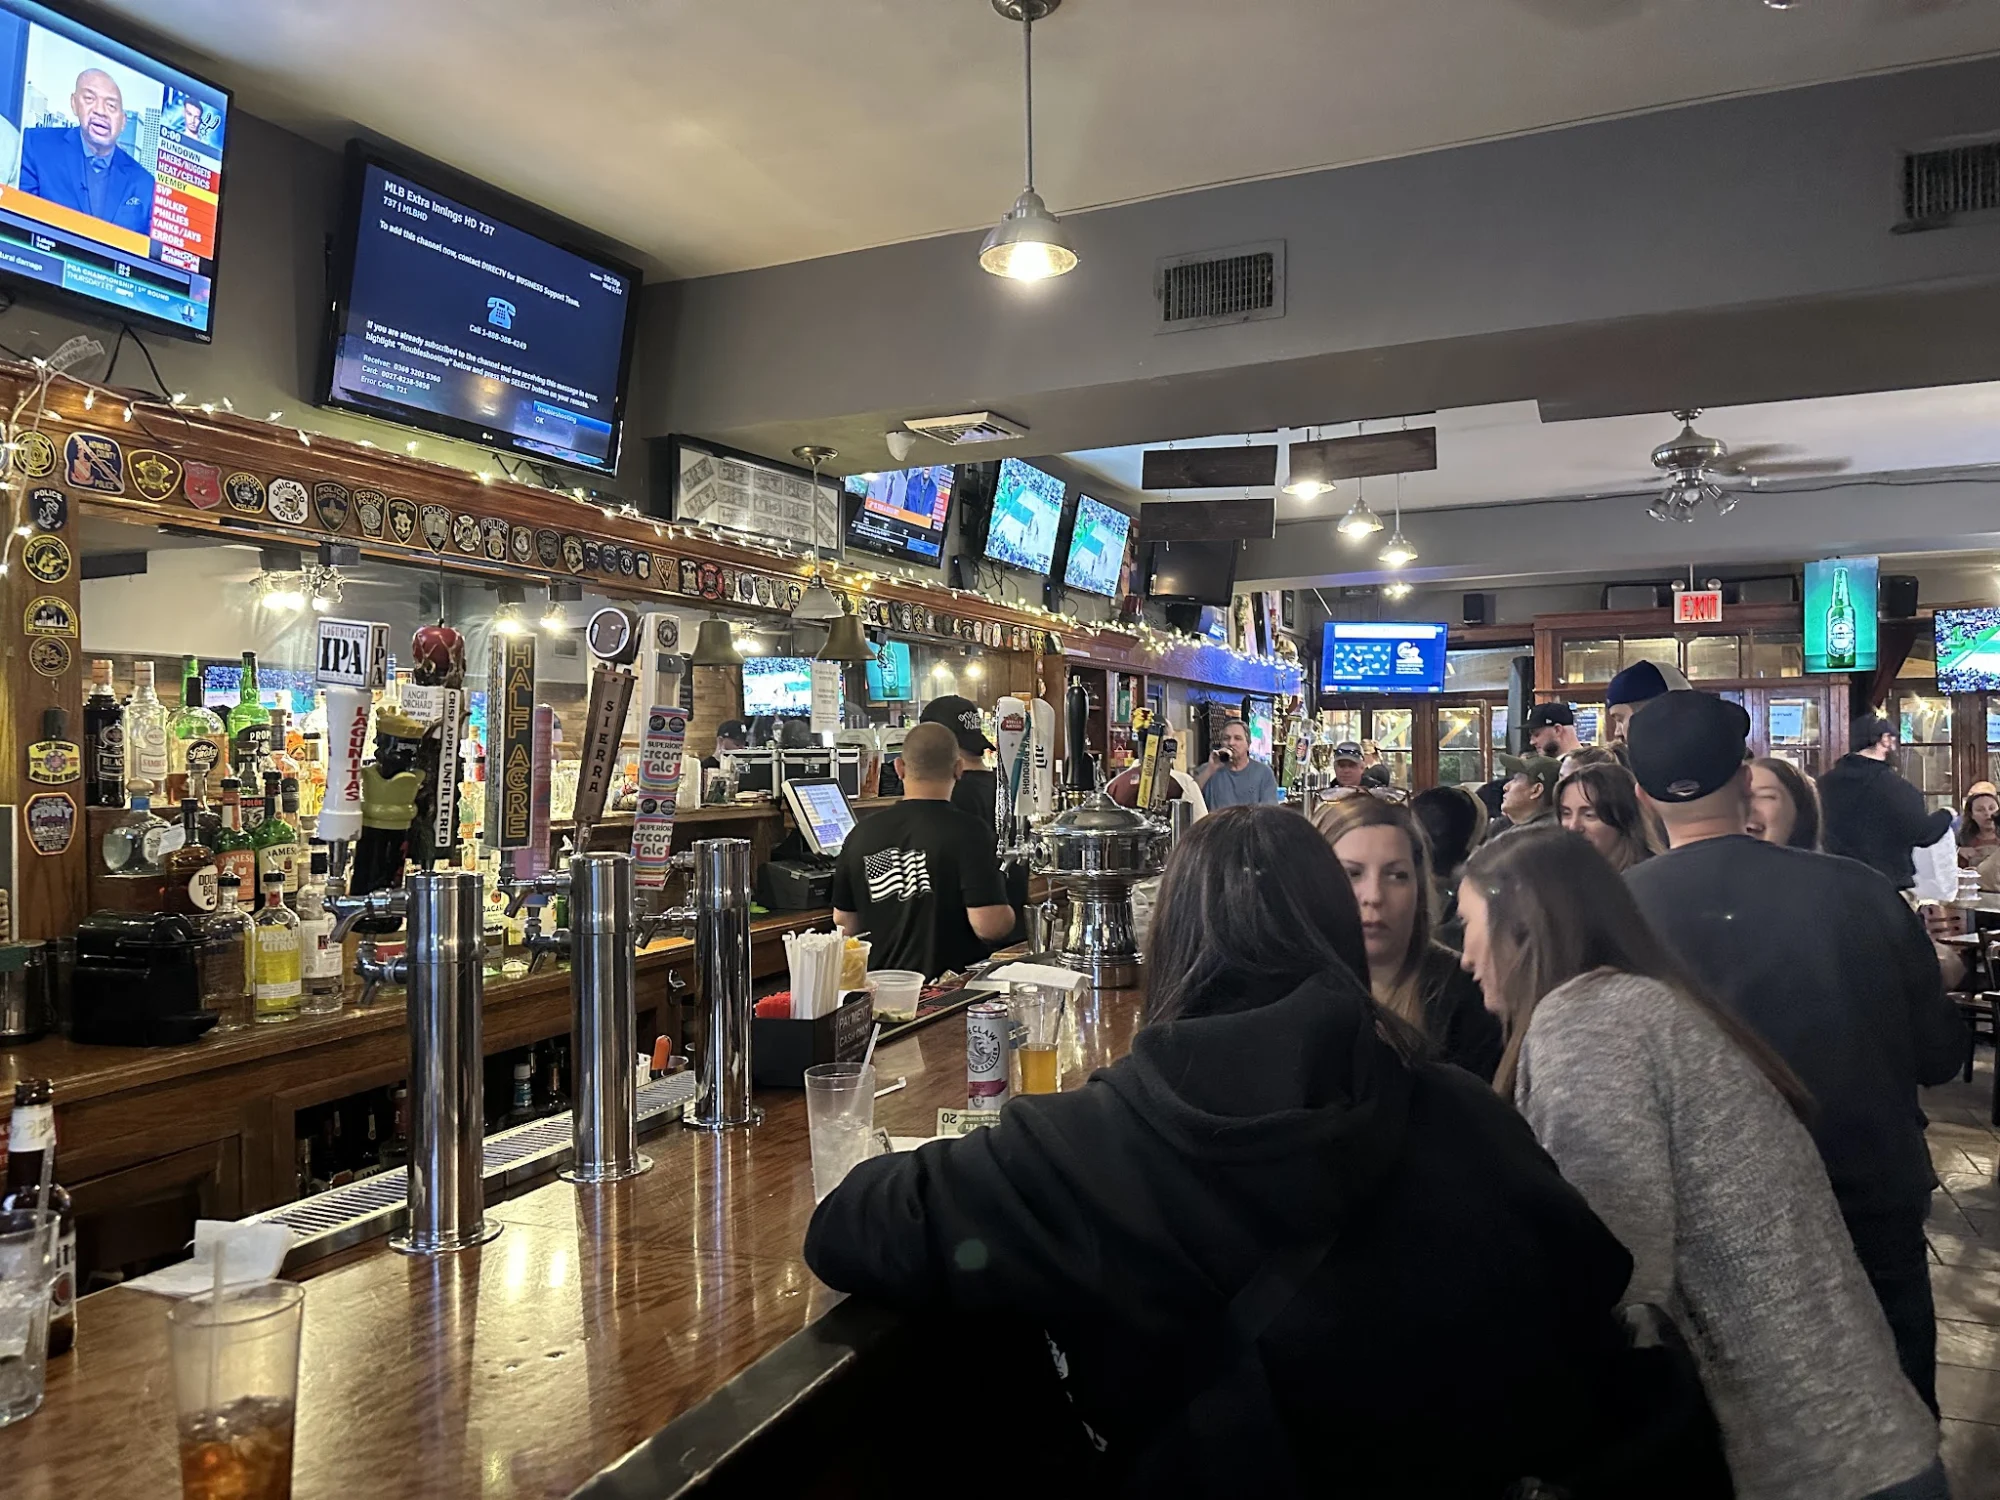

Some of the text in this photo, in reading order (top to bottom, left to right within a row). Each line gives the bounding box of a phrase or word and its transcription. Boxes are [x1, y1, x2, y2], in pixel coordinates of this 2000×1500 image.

[161, 127, 181, 142] 0:00
[161, 139, 200, 162] RUNDOWN
[160, 150, 212, 180] LAKERS/NUGGETS
[158, 161, 210, 190] HEAT/CELTICS
[158, 173, 187, 191] WEMBY
[155, 184, 173, 197] SVP
[155, 195, 188, 214] MULKEY
[383, 196, 397, 209] 737
[402, 204, 429, 221] MLBHD
[384, 180, 496, 237] MLB Extra Innings HD 737
[154, 206, 189, 227] PHILLIES
[151, 228, 185, 248] ERRORS
[152, 217, 202, 243] YANKS/JAYS
[379, 219, 389, 230] To
[389, 224, 403, 236] add
[403, 230, 416, 241] this
[416, 236, 443, 253] channel
[442, 247, 458, 260] now,
[457, 253, 481, 268] contact
[480, 261, 507, 279] DIRECTV
[506, 271, 516, 281] for
[515, 275, 544, 293] BUSINESS
[543, 286, 565, 301] Support
[67, 271, 101, 288] THURSDAY
[82, 267, 134, 290] CHAMPIONSHIP
[147, 289, 170, 302] ROUND
[469, 324, 482, 335] Call
[363, 354, 391, 369] Receiver:
[366, 320, 374, 329] If
[374, 323, 387, 333] you
[388, 328, 399, 337] are
[400, 332, 424, 347] already
[425, 340, 458, 356] subscribed
[458, 350, 466, 358] to
[466, 353, 476, 362] the
[477, 357, 500, 369] channel
[500, 364, 512, 374] and
[512, 369, 522, 377] are
[522, 372, 546, 387] receiving
[546, 379, 557, 389] this
[557, 383, 579, 397] message
[362, 365, 379, 376] Card:
[365, 332, 590, 409] highlight "Troubleshooting" below and press the SELECT button on your remote.
[360, 375, 377, 386] Error
[378, 380, 395, 390] Code:
[535, 416, 545, 425] OK
[536, 406, 577, 425] Troubleshooting
[88, 440, 112, 452] HOWARD
[96, 448, 117, 460] COUNTY
[94, 479, 115, 490] POLICE
[229, 474, 262, 491] DETROIT
[34, 489, 63, 502] POLICE
[273, 481, 305, 503] CHICAGO
[318, 486, 347, 498] POLICE
[356, 491, 384, 505] BOSTON
[235, 502, 259, 511] POLICE
[273, 504, 304, 521] POLICE
[358, 499, 381, 509] POLICE
[422, 506, 450, 522] POLICE
[482, 519, 509, 535] POLICE
[1680, 594, 1717, 621] EXIT
[323, 625, 359, 639] LAGUNITAS
[320, 636, 363, 675] IPA
[372, 629, 385, 685] IPA
[407, 690, 428, 700] ANGRY
[403, 700, 433, 710] ORCHARD
[506, 643, 532, 839] HALF ACRE
[588, 700, 614, 793] SIERRA
[647, 740, 682, 750] SUPERIOR
[188, 746, 218, 760] Smoky
[344, 706, 367, 801] LAGUNITAS
[438, 691, 456, 845] CRISP APPLE UNFILTERED
[651, 761, 673, 774] ale
[1022, 751, 1031, 795] BOROUGHS
[31, 805, 73, 821] FDNY
[638, 821, 673, 832] SUPERIOR
[642, 845, 664, 856] ale
[262, 941, 299, 953] CITRON
[839, 1004, 870, 1028] PAYMENT
[839, 1025, 870, 1047] CASH ONLY
[972, 1025, 997, 1041] CLAW
[979, 1046, 998, 1071] SELTZER
[941, 1112, 957, 1124] 20
